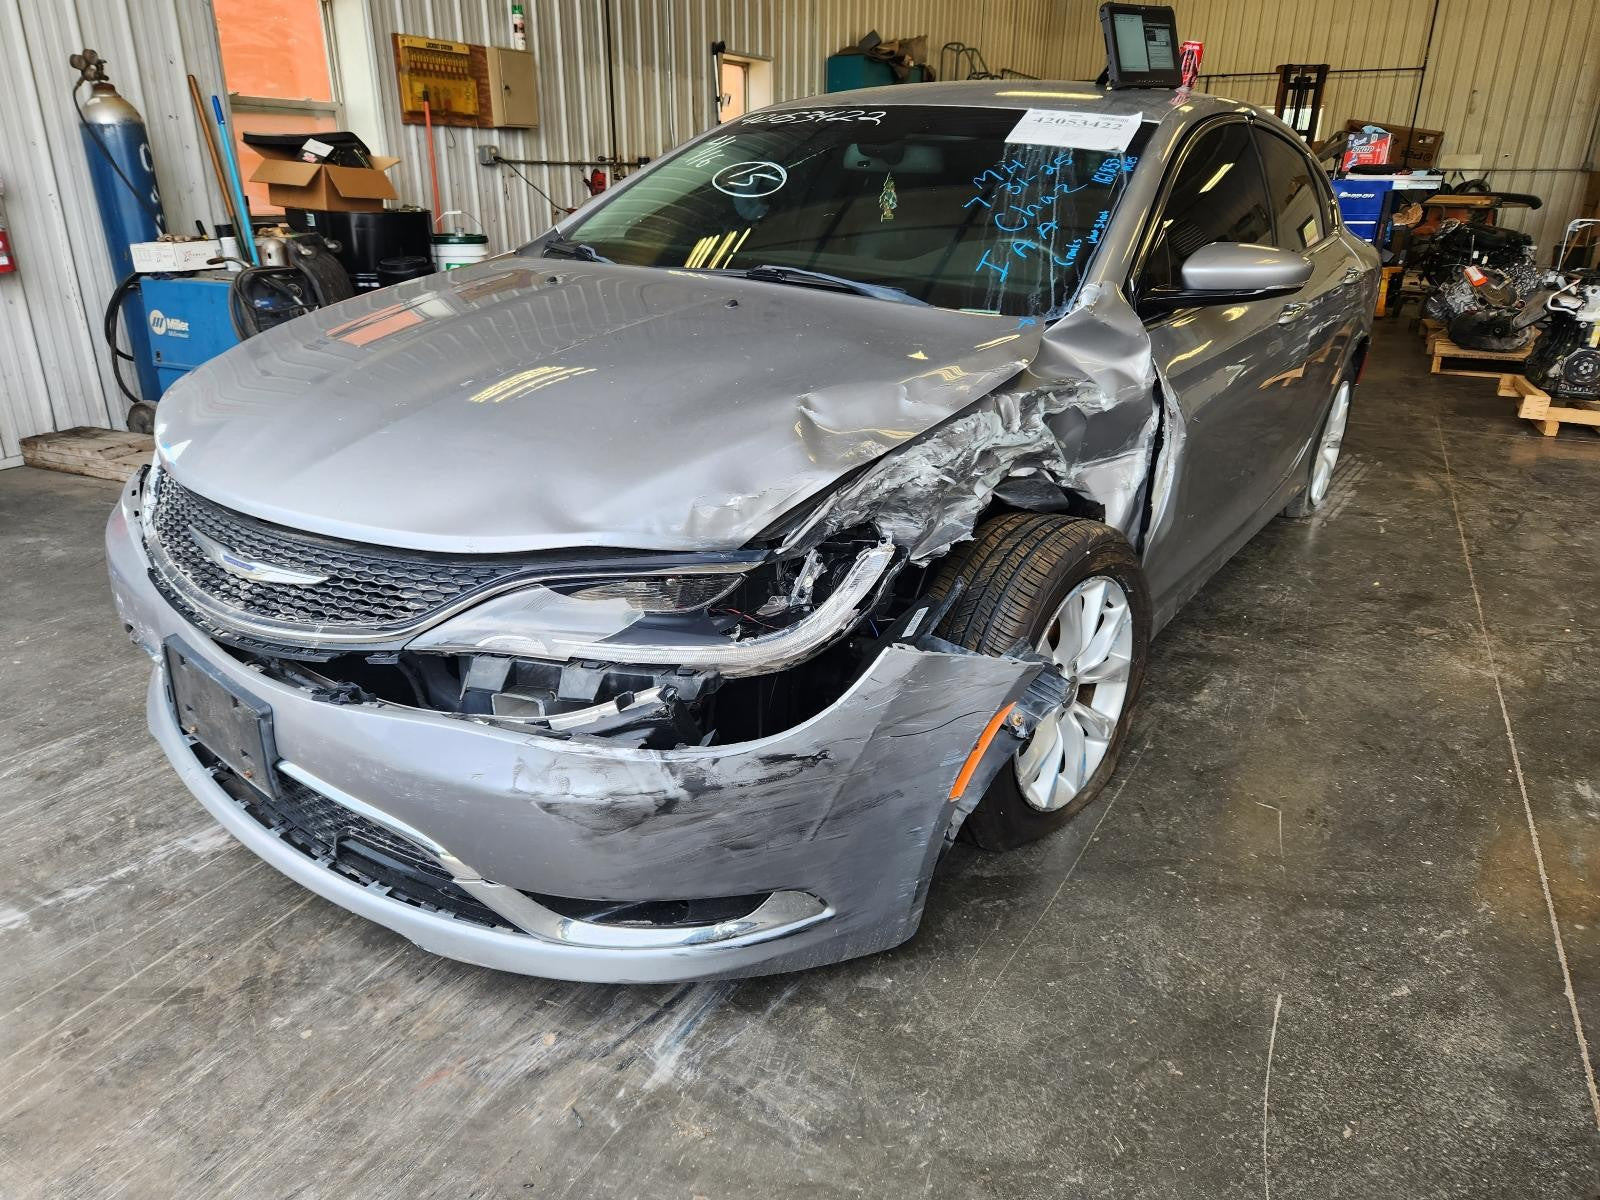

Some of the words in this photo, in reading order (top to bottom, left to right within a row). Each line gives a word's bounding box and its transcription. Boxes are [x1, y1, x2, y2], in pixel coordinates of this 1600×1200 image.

[1033, 117, 1123, 130] 42053422
[1352, 146, 1374, 154] SHOP
[166, 318, 189, 331] Miller
